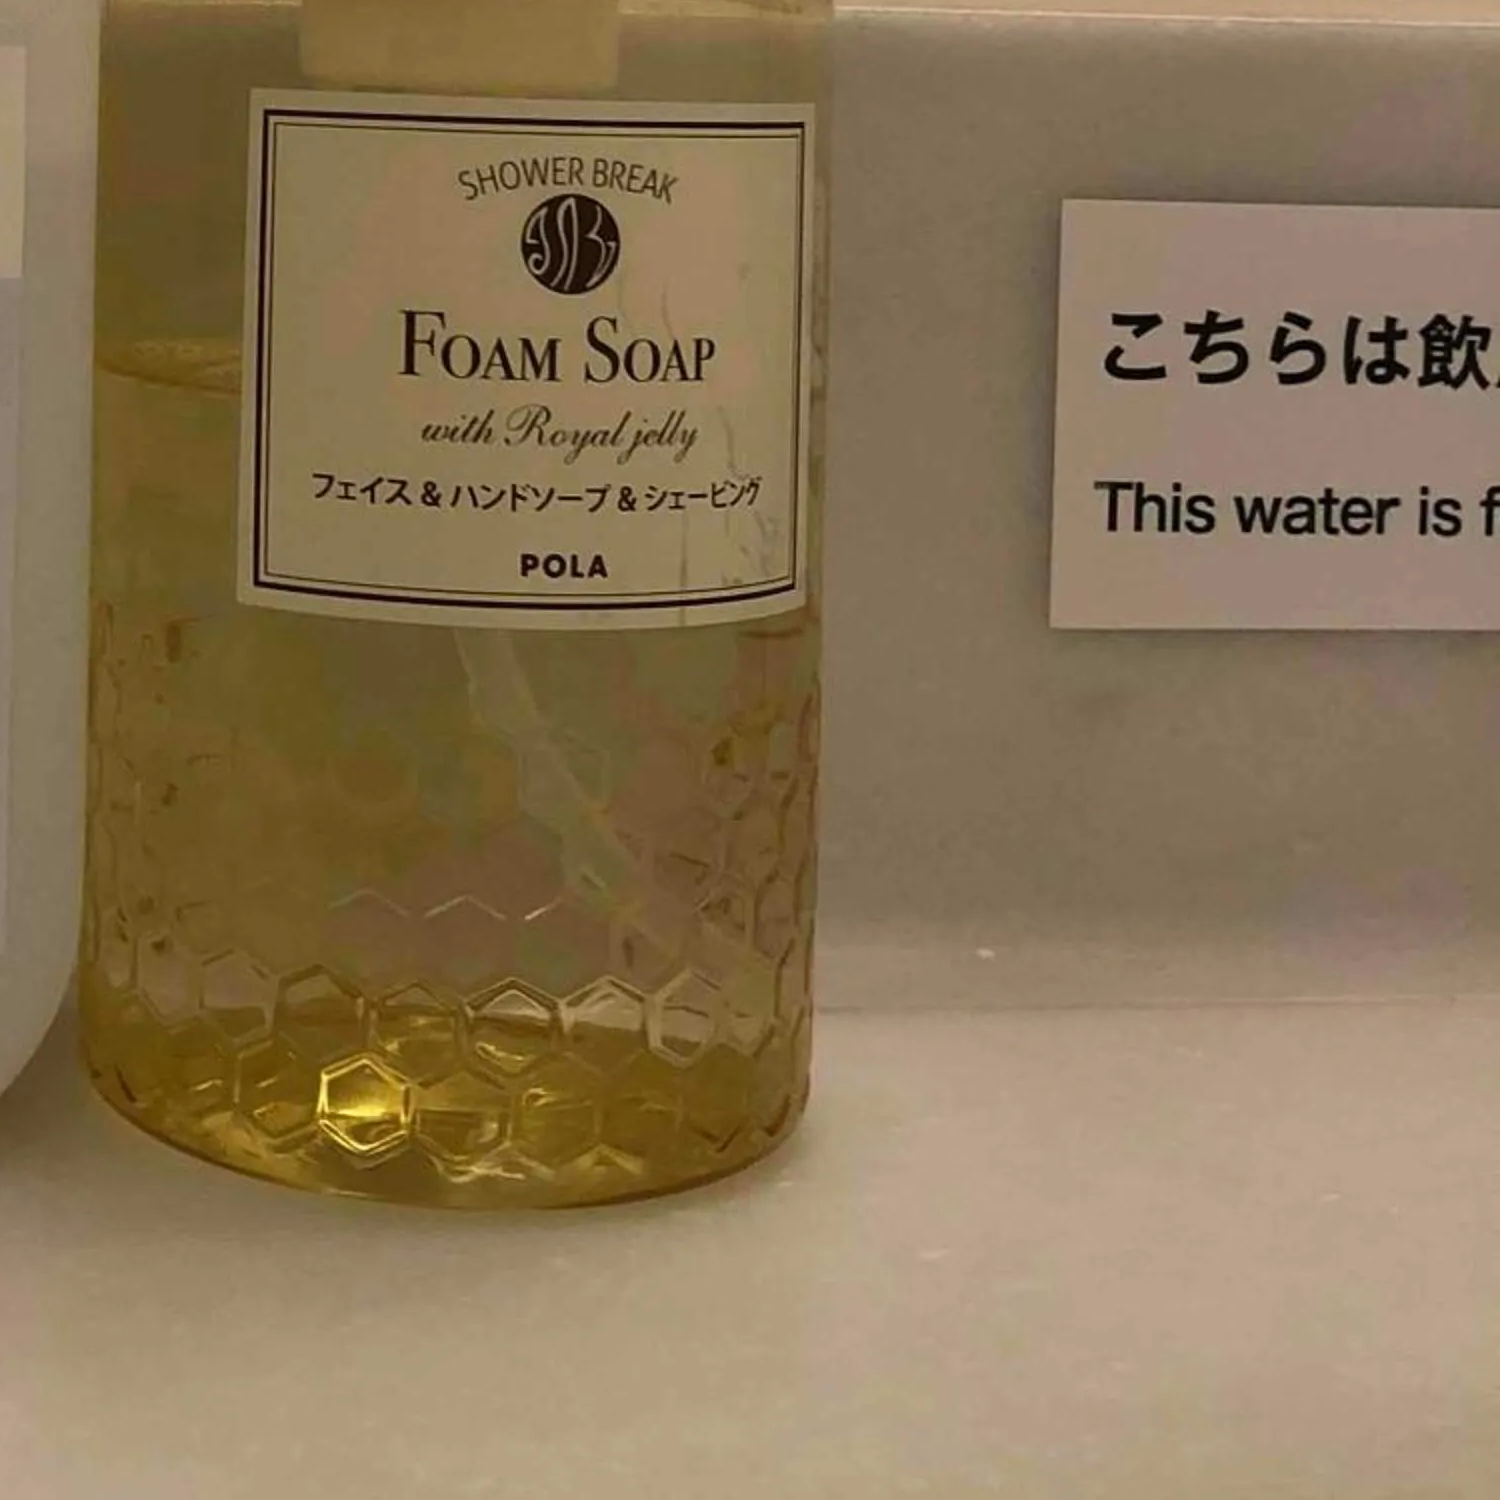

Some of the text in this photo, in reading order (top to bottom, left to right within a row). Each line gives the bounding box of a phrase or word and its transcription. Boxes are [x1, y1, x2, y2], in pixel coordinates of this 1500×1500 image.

[458, 156, 679, 204] SHOWER BREAK
[398, 309, 716, 383] FOAM SOAP
[1103, 309, 1500, 390] こちらは飲
[421, 404, 699, 465] with Royal jelly
[1094, 481, 1216, 534] This
[1233, 488, 1401, 536] water
[1418, 486, 1463, 537] is
[519, 553, 609, 579] POLA
